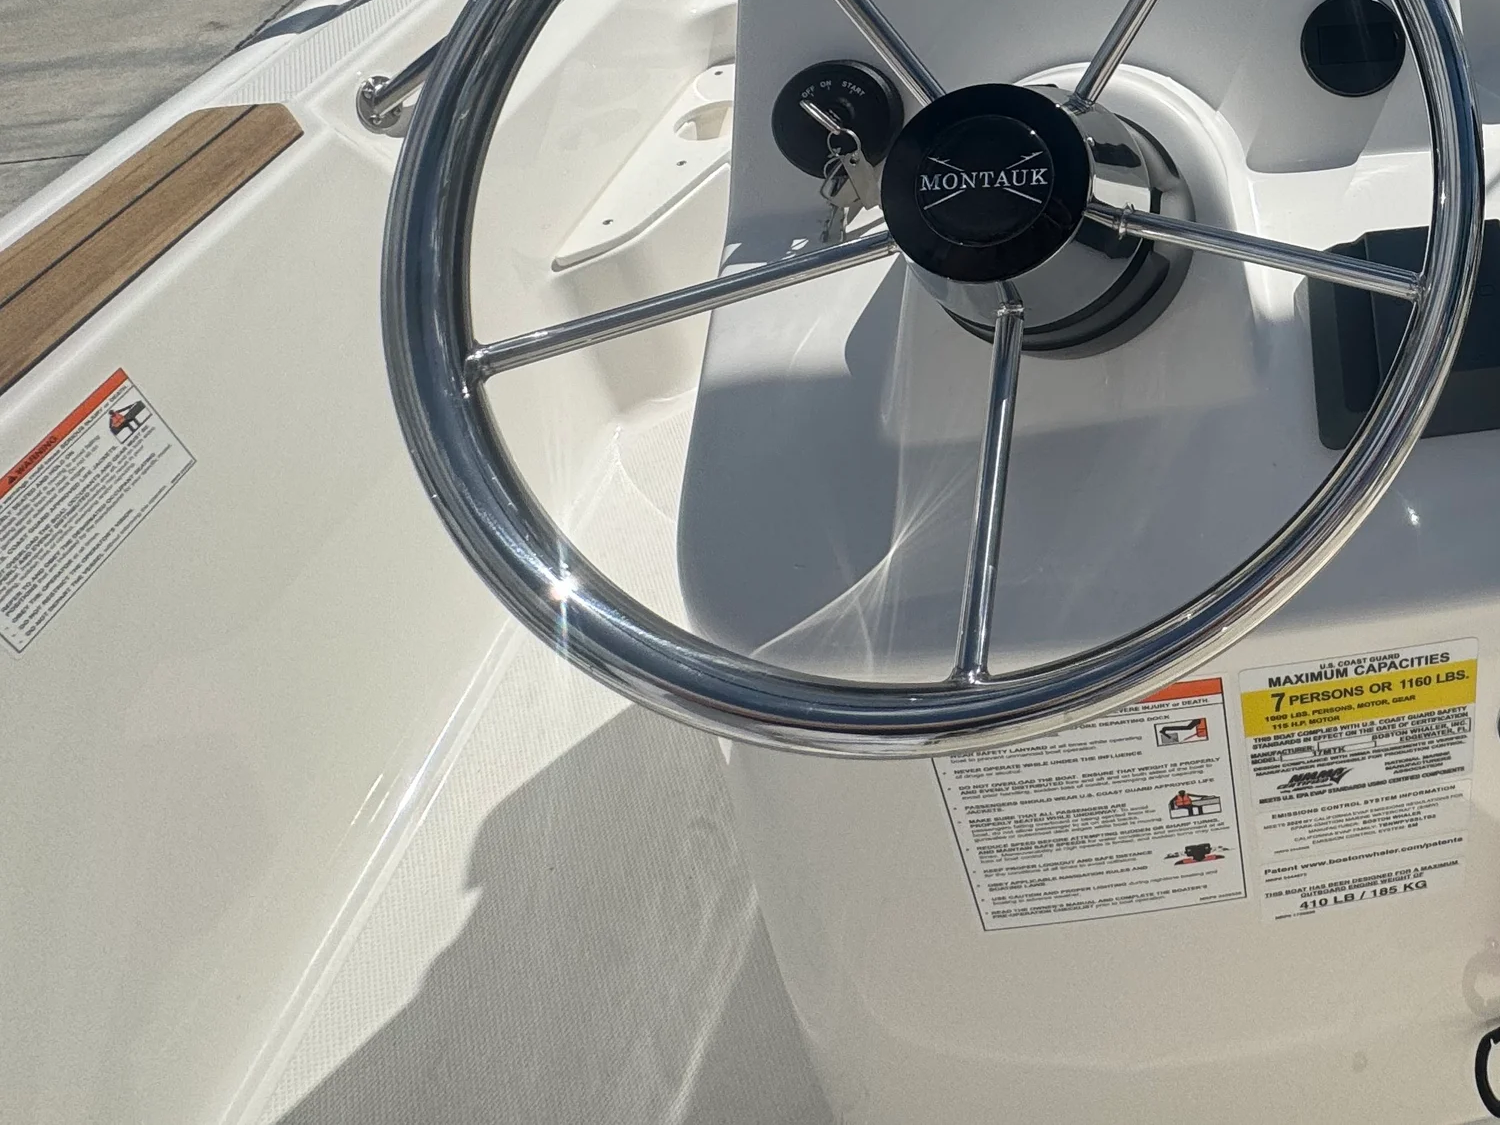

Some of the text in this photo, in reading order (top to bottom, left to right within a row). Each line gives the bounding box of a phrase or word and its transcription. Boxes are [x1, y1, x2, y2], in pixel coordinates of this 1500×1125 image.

[801, 86, 815, 99] OFF
[819, 80, 832, 89] ON
[841, 80, 866, 97] START
[919, 168, 1048, 192] MONTAUK
[15, 435, 58, 475] WARNING
[1268, 651, 1449, 689] MAXIMUM CAPACITIES
[1319, 652, 1399, 670] U.S. COAST GUARD
[1270, 669, 1469, 712] 7 PERSONS OR 1160 LBS.
[1116, 706, 1139, 714] VERE
[1141, 702, 1169, 710] INJURY
[1181, 697, 1207, 706] DEATH
[1290, 710, 1309, 719] LBS.
[1312, 703, 1354, 716] PERSONS,
[1392, 693, 1415, 703] GEAR
[1252, 737, 1301, 750] STANDARDS
[1313, 731, 1342, 741] EFFECT
[1376, 723, 1396, 731] DATE
[1411, 711, 1468, 725] CERTIFICATION
[1272, 722, 1288, 731] 115
[1309, 714, 1339, 725] MOTOR
[1297, 726, 1337, 737] COMPLIES
[1340, 722, 1359, 730] WITH
[1379, 715, 1404, 724] COAST
[1407, 710, 1435, 719] GUARD
[1437, 705, 1466, 714] SAFETY
[1372, 729, 1407, 740] BOSTON
[953, 766, 981, 775] NEVER
[1271, 784, 1455, 819] EMISSIONS CONTROL SYSTEM INFORMATION
[1264, 864, 1297, 875] Patent
[1264, 890, 1283, 898] THIS
[1285, 886, 1306, 895] BOAT
[1328, 879, 1350, 887] BEEN
[1352, 872, 1392, 883] DESIGNED
[1421, 860, 1458, 870] MAXIMUM
[1299, 897, 1328, 909] 410
[1333, 892, 1354, 903] LB
[1371, 885, 1397, 897] 185
[1403, 879, 1427, 891] KG
[1300, 885, 1346, 897] OUTBOARD
[1348, 879, 1378, 889] ENGINE
[1380, 874, 1411, 884] WEIGHT
